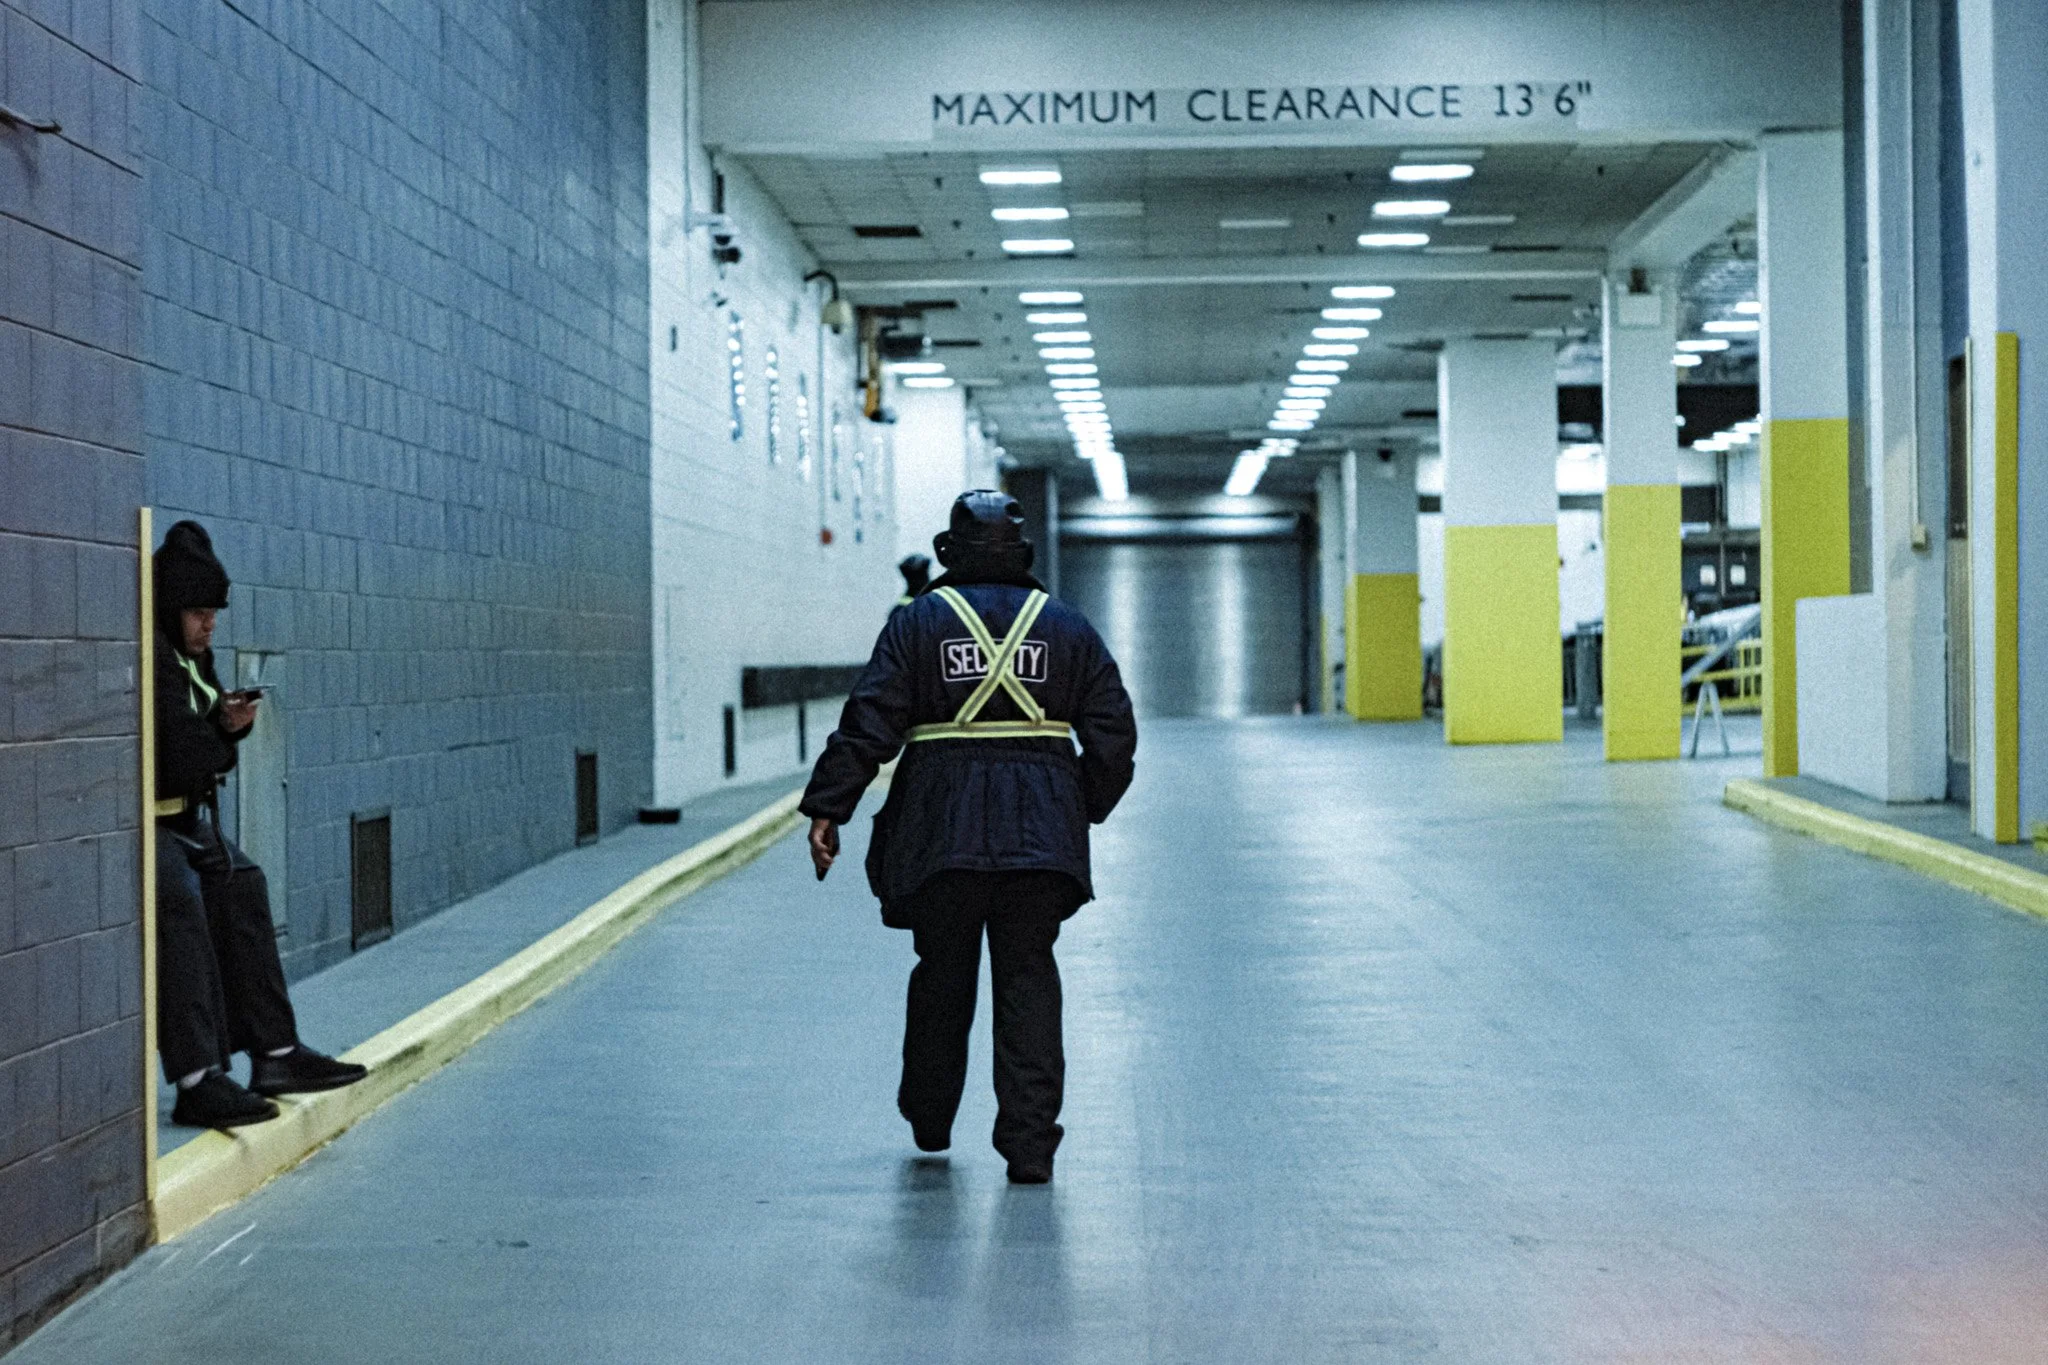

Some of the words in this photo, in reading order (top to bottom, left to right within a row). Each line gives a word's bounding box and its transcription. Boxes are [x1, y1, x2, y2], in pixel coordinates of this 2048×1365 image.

[933, 90, 1157, 125] MAXIMUM
[1187, 85, 1462, 122] CLEARANCE
[947, 643, 1042, 676] SECTY
